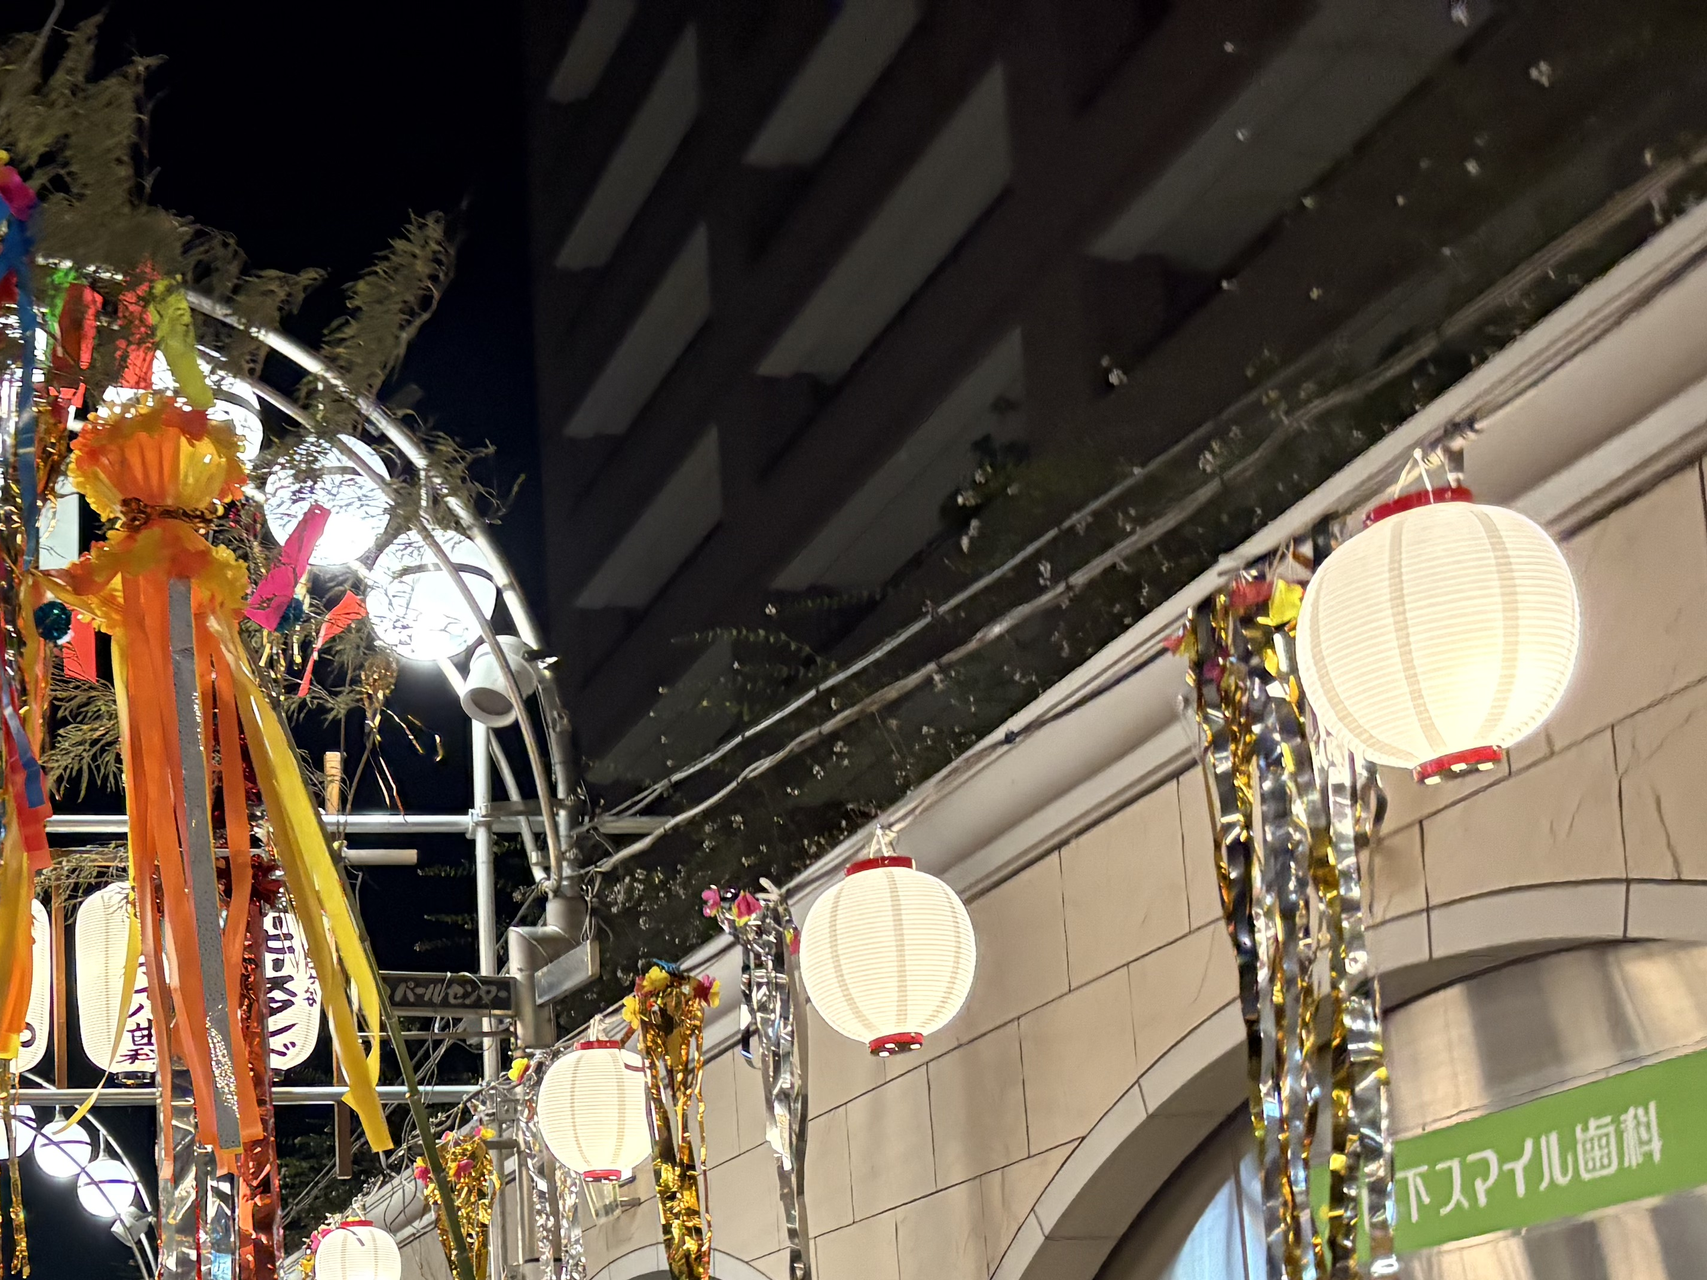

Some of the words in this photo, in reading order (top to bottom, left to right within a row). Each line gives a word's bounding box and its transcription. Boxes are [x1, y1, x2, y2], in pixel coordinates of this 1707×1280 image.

[1362, 1101, 1663, 1233] 下スマイル歯科
